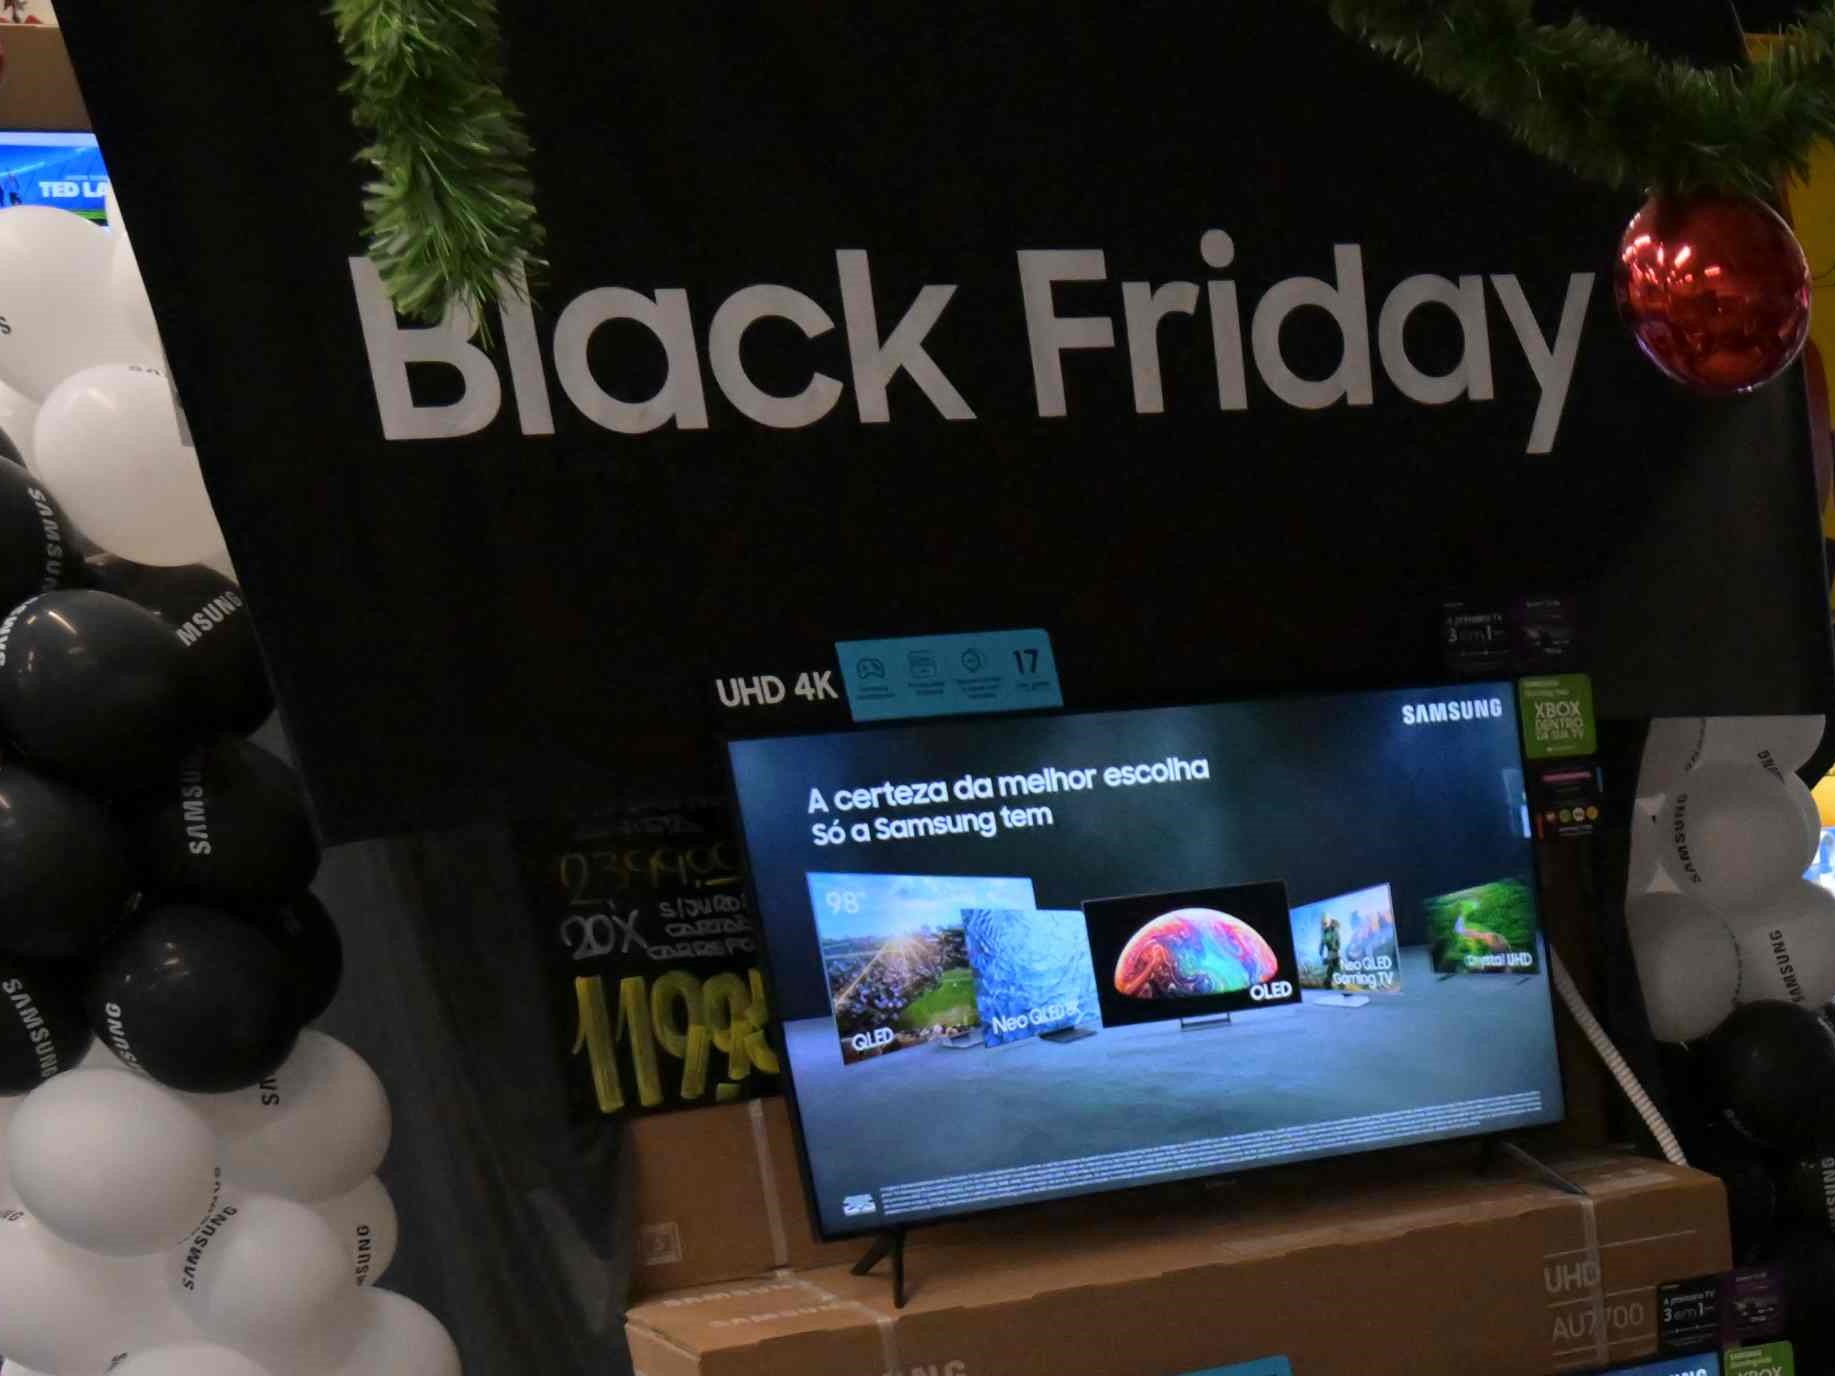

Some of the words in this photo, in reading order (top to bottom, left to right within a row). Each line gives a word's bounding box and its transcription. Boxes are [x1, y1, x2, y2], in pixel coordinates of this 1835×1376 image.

[39, 181, 79, 198] TED
[350, 250, 977, 441] Black
[1017, 228, 1597, 455] Friday
[1012, 648, 1041, 675] 17
[715, 675, 786, 708] UHD
[793, 670, 840, 702] 4K
[1402, 697, 1502, 726] SAMSUNG
[1534, 700, 1582, 719] XBOX
[807, 786, 830, 814] A
[833, 778, 950, 812] certeza
[953, 773, 995, 800] da
[997, 766, 1098, 799] melhor
[1103, 755, 1211, 788] escolha
[811, 817, 848, 849] Só
[851, 822, 872, 842] a
[875, 807, 998, 840] Samsung
[1000, 803, 1054, 830] tem
[1506, 951, 1534, 967] UHD
[1249, 981, 1294, 1002] OLED
[991, 1012, 1028, 1037] Neo
[852, 1026, 895, 1052] QLED
[182, 1205, 238, 1291] SAMSUNG
[1543, 1260, 1601, 1294] UHD
